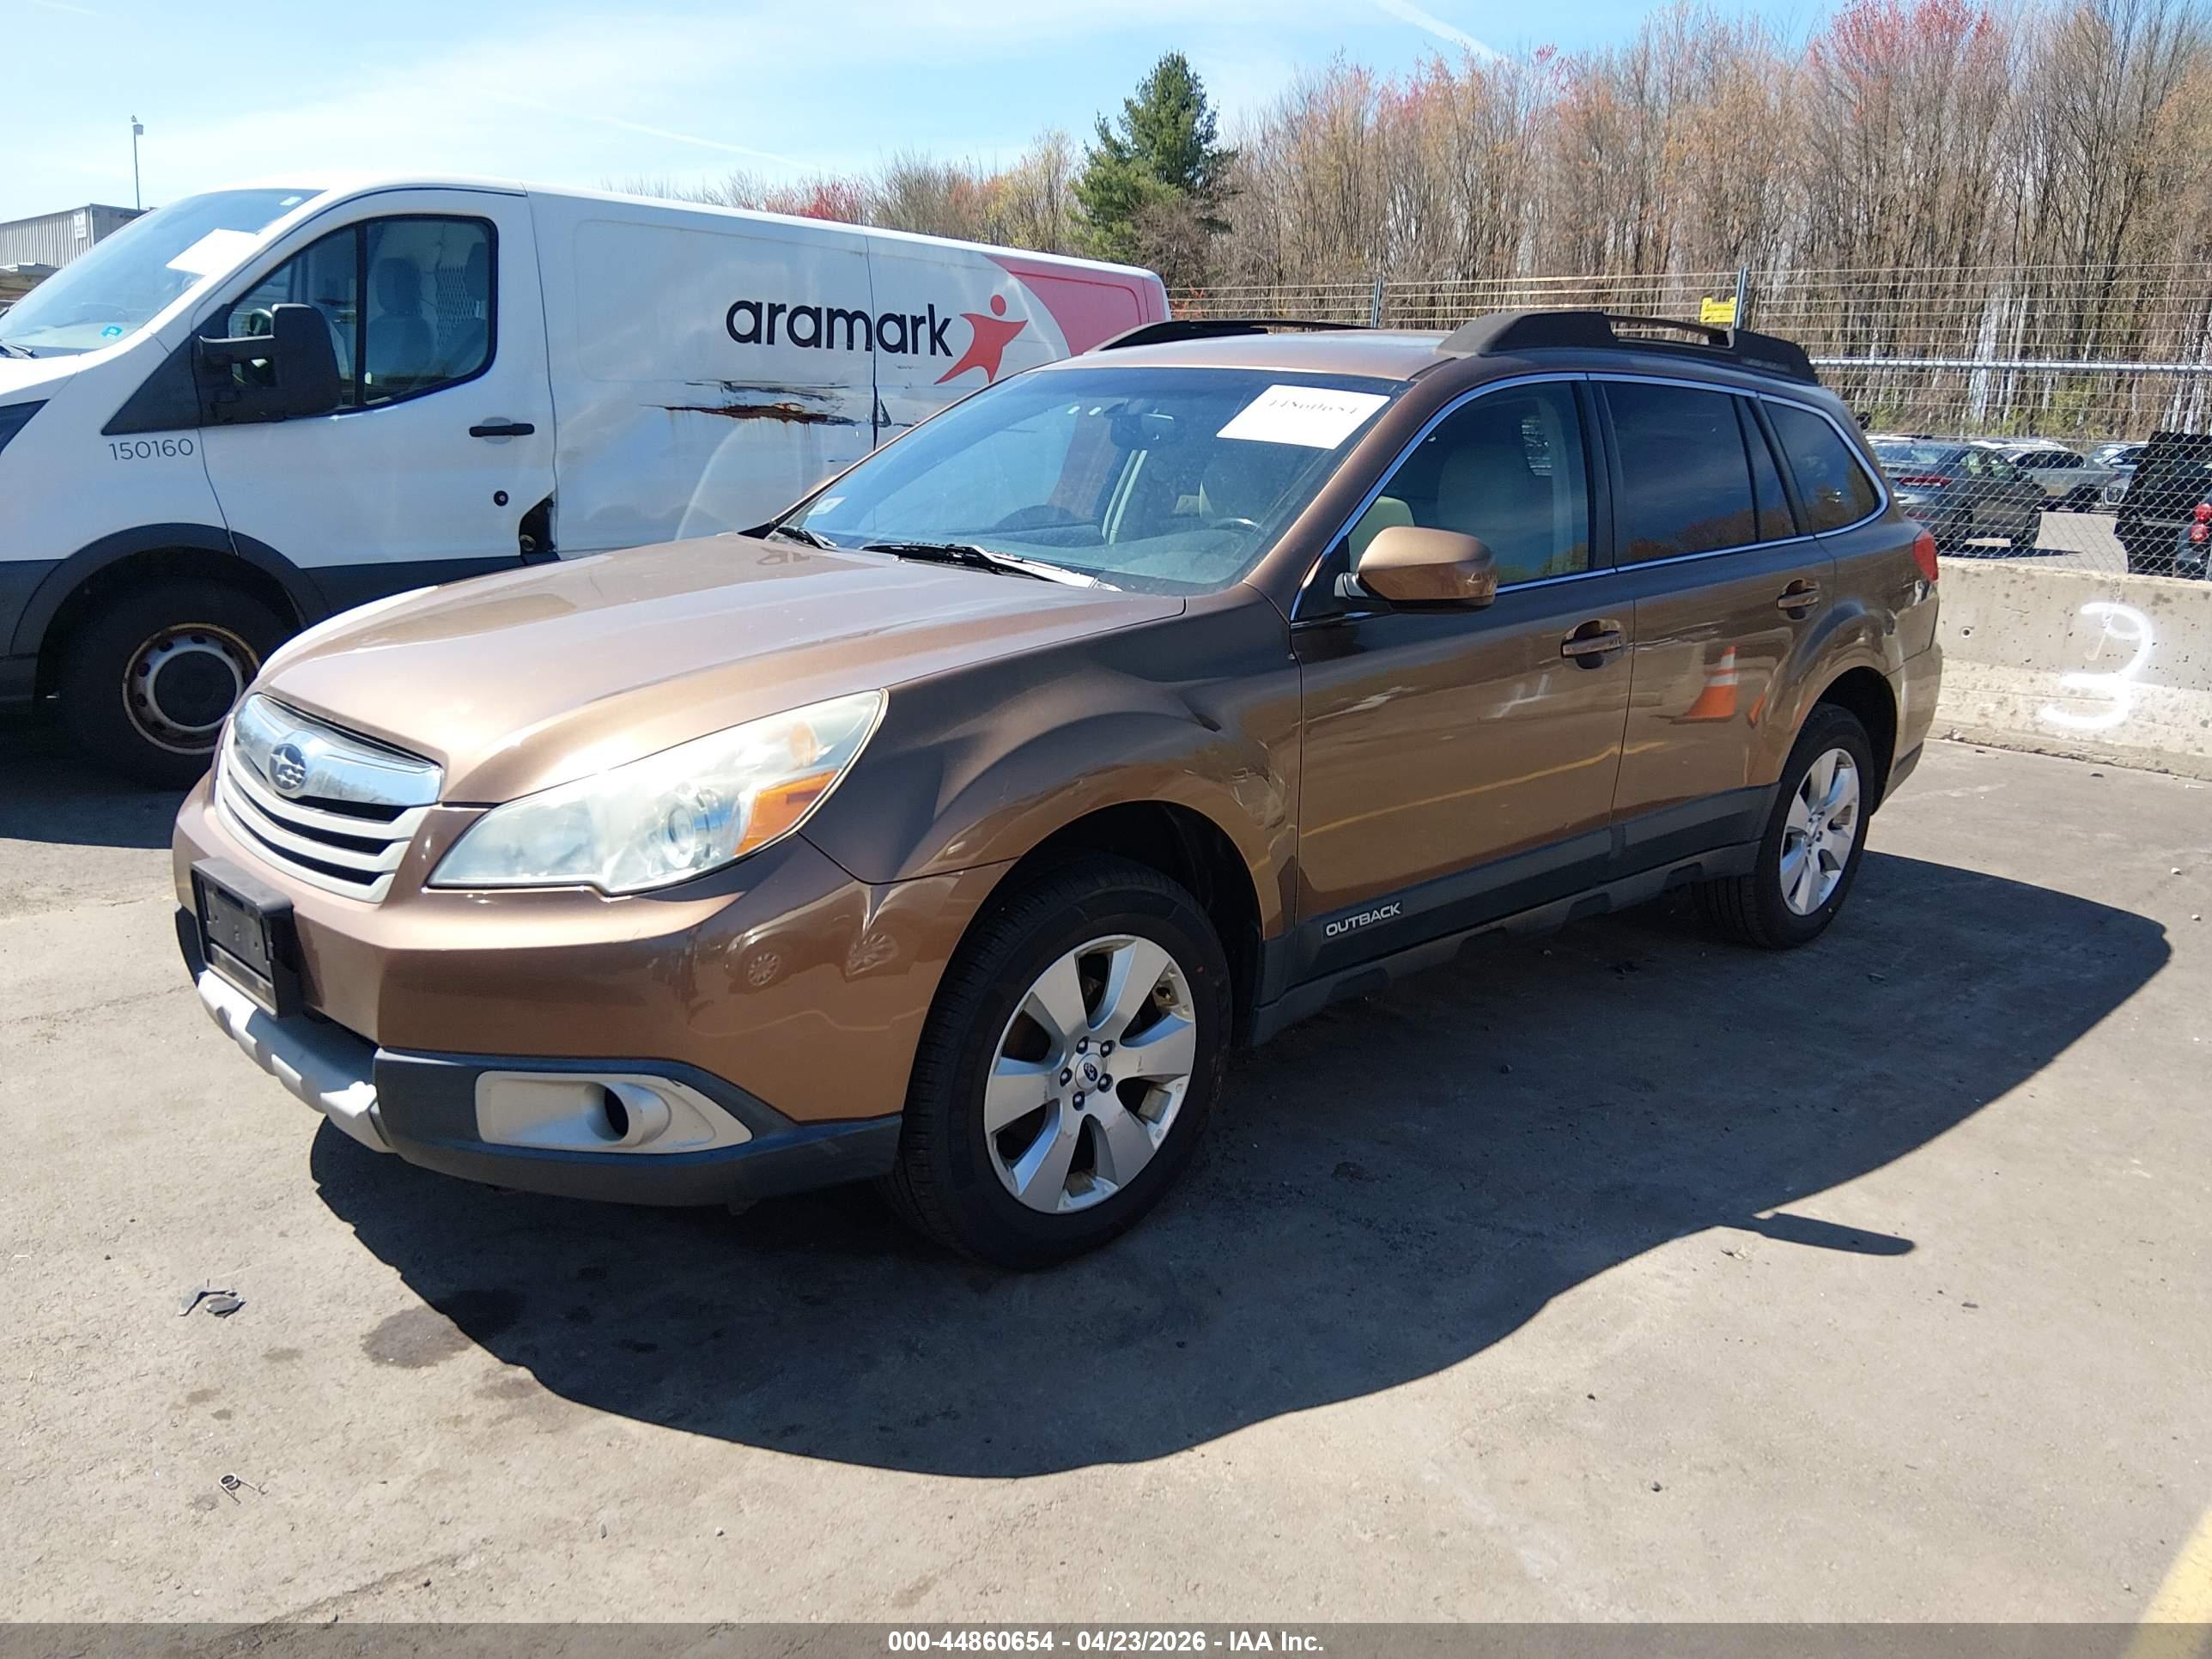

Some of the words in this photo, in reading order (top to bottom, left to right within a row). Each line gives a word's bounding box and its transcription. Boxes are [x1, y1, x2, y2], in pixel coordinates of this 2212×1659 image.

[726, 300, 954, 358] aramark
[108, 438, 194, 461] 150160
[1325, 902, 1401, 937] OUTBACK
